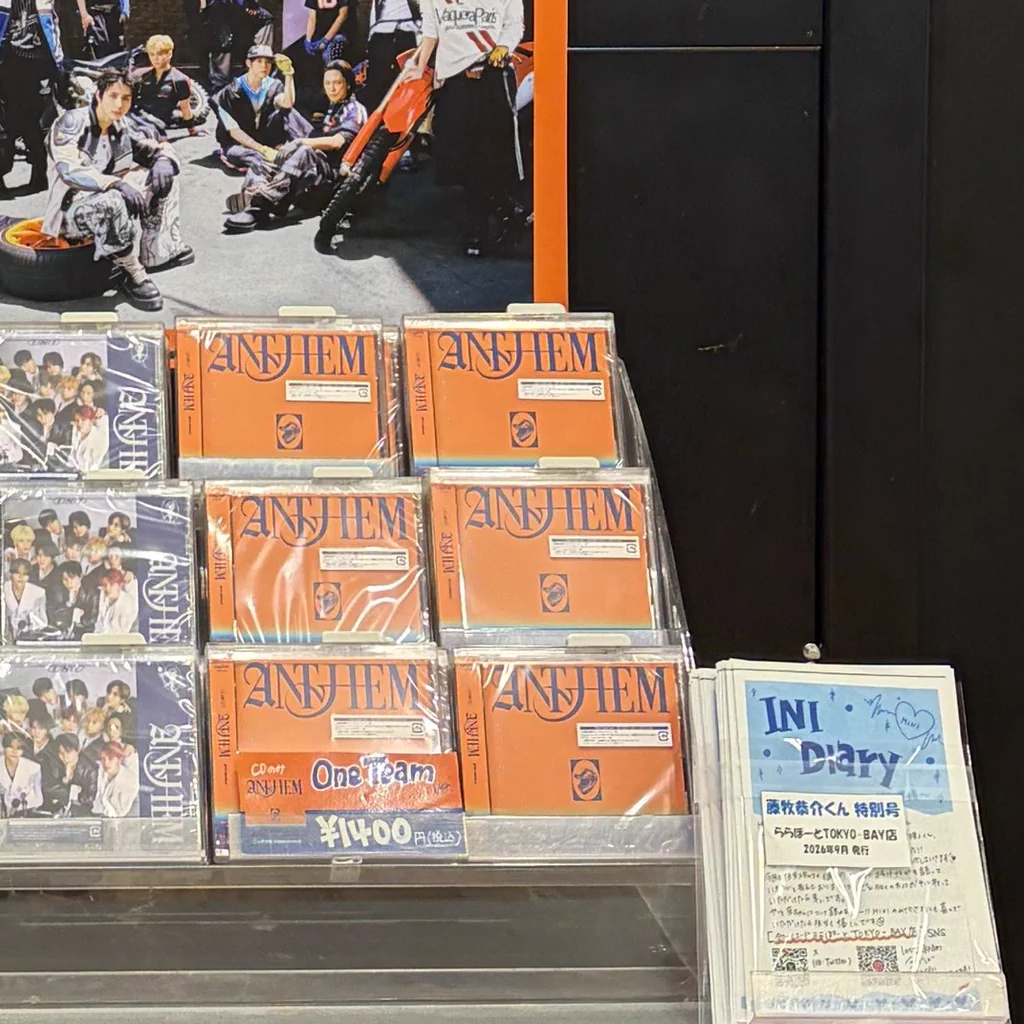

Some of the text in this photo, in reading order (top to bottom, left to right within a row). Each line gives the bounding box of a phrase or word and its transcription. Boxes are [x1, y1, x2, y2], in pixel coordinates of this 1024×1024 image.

[207, 331, 369, 382] ANTHEM
[437, 329, 604, 380] ANTHEM
[239, 495, 407, 549] ANTHEM
[463, 486, 634, 540] ANTHEM
[243, 663, 418, 718] ANTHEM
[490, 667, 671, 723] ANTHEM
[760, 696, 823, 735] INI
[311, 758, 363, 791] One
[315, 814, 412, 849] ¥1400
